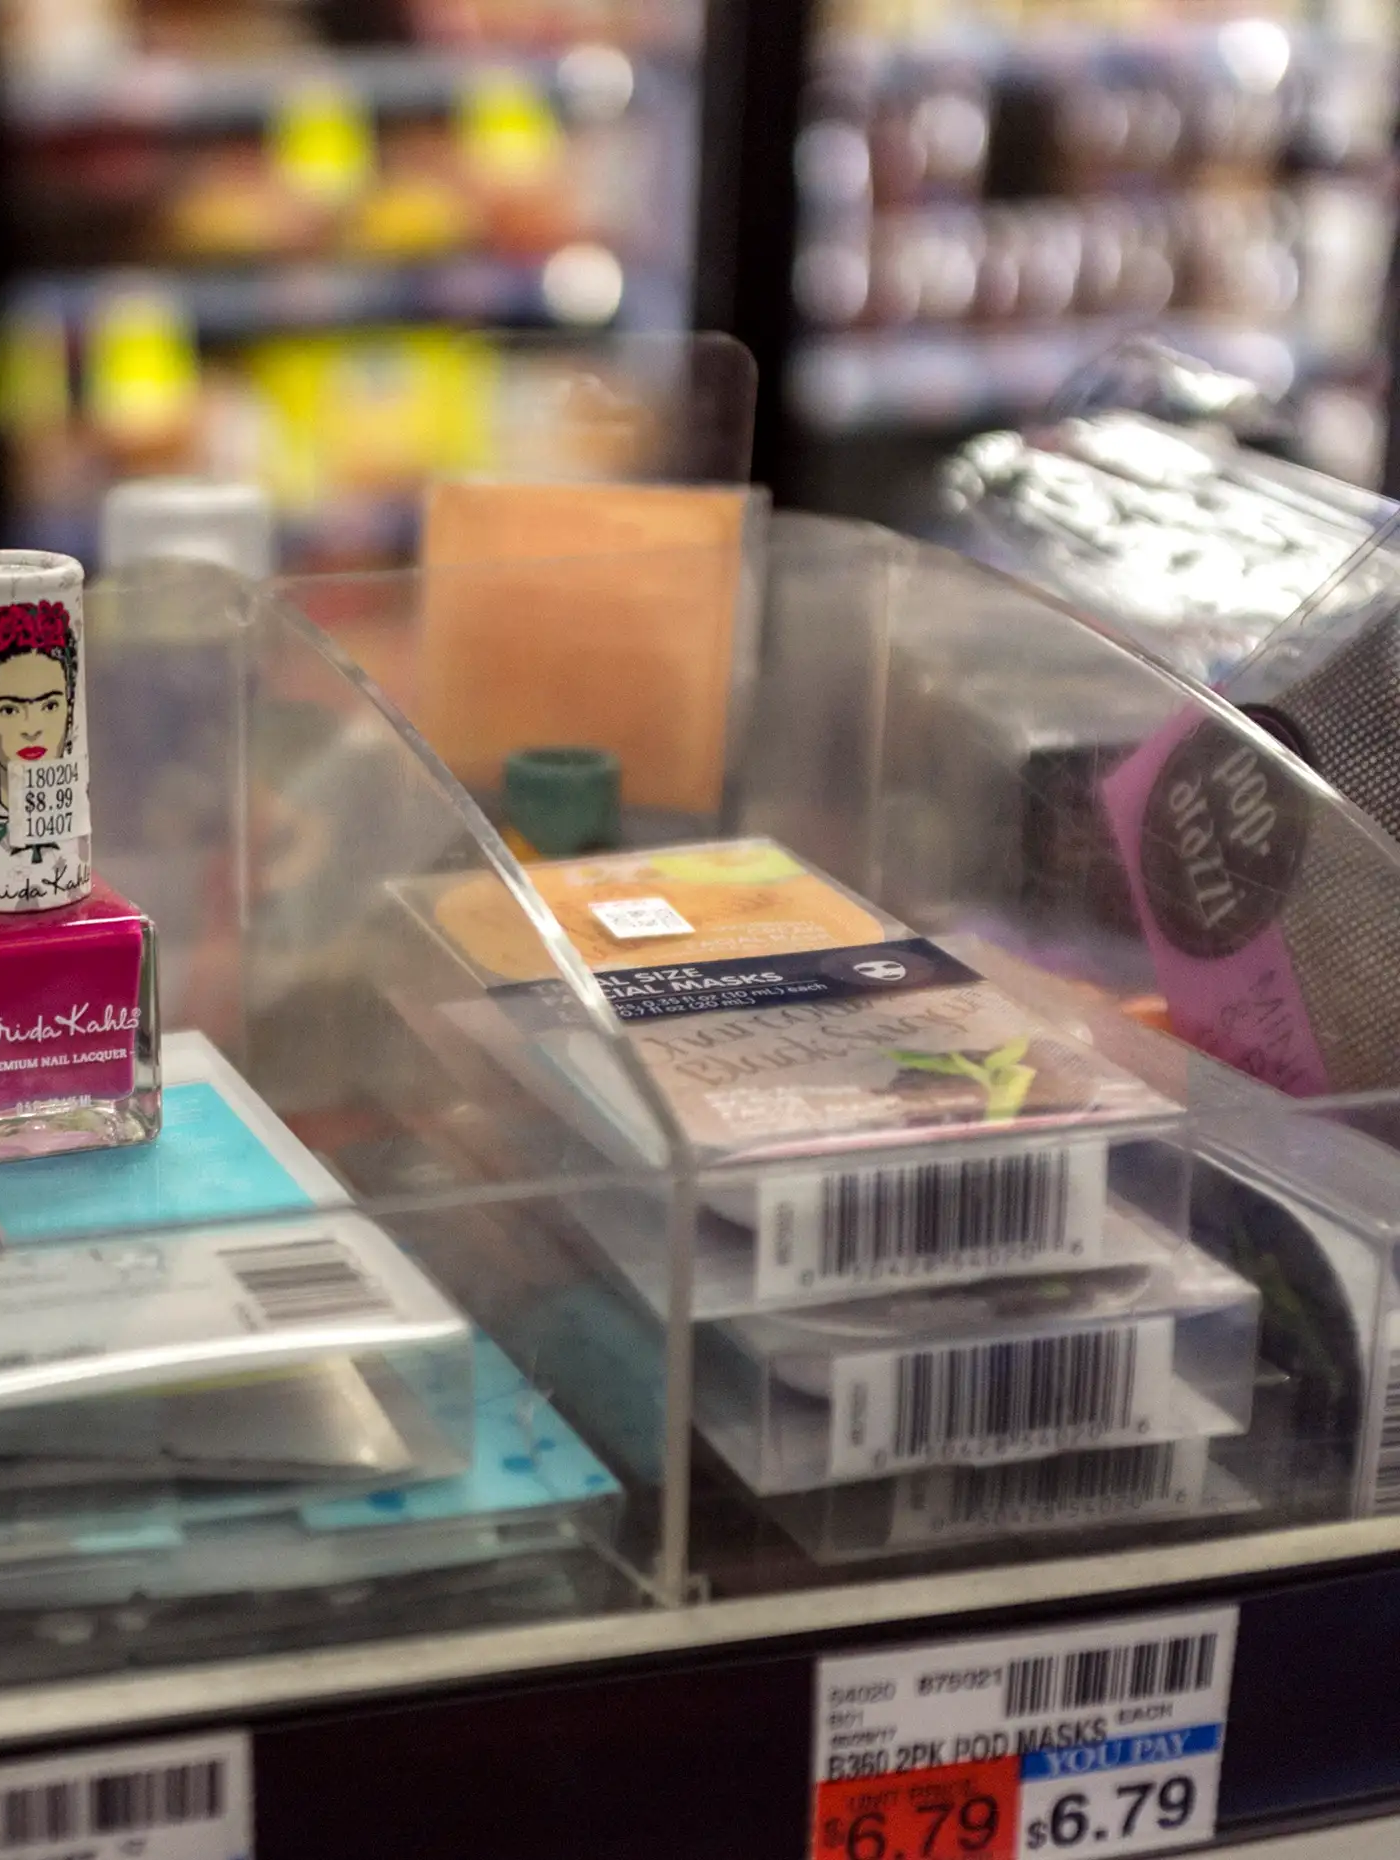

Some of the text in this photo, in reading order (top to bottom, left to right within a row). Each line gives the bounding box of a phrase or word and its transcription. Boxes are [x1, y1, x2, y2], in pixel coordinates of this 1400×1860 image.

[26, 762, 79, 789] 180204
[24, 787, 73, 814] $8.99
[26, 812, 73, 838] 10407
[633, 967, 703, 984] SIZE
[669, 972, 785, 993] MASKS
[787, 982, 829, 994] each
[41, 1053, 71, 1067] NAIL
[72, 1047, 128, 1065] LACQUER
[895, 1740, 945, 1774] 2PK
[955, 1729, 1010, 1764] POD
[1017, 1718, 1108, 1753] MASKS
[1043, 1729, 1192, 1777] YOU PAY
[1026, 1774, 1198, 1850] $6.79
